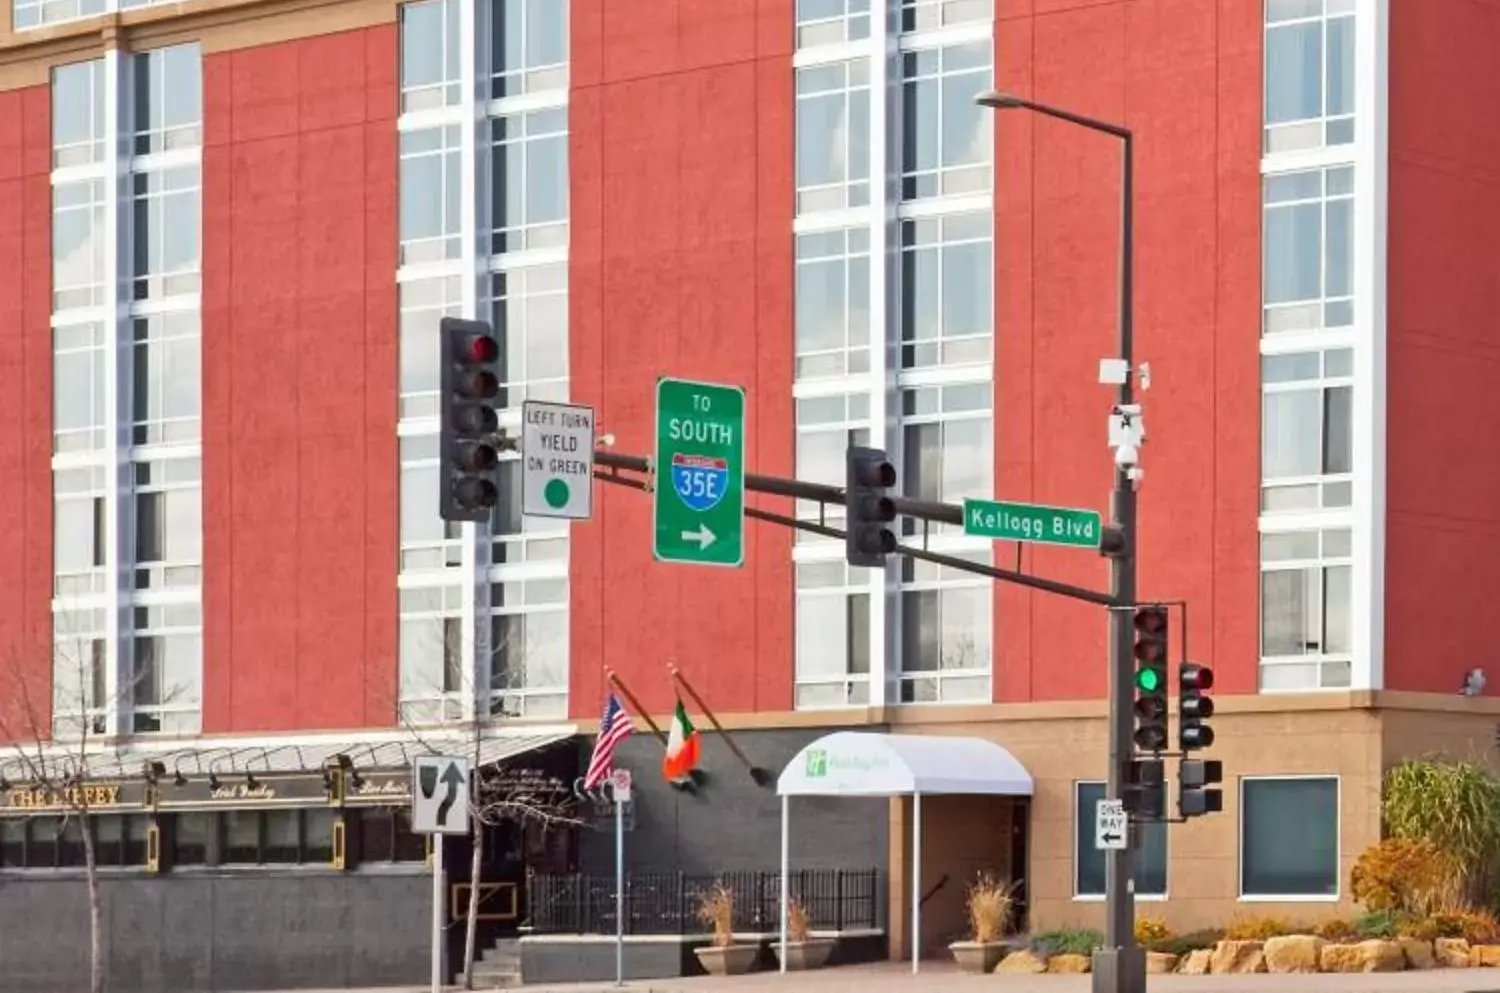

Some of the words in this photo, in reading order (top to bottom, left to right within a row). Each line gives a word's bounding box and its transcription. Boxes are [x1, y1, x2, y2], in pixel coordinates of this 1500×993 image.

[692, 394, 711, 412] TO
[527, 410, 555, 426] LEFT
[561, 412, 590, 429] TURN
[669, 418, 733, 445] SOUTH
[540, 434, 578, 452] YIELD
[528, 456, 544, 471] ON
[549, 458, 587, 474] GREEN
[681, 471, 718, 499] 35E
[971, 508, 1043, 538] Kellogg
[1052, 516, 1093, 538] Blvd
[1101, 803, 1124, 816] ONE
[1100, 817, 1124, 829] WAY
